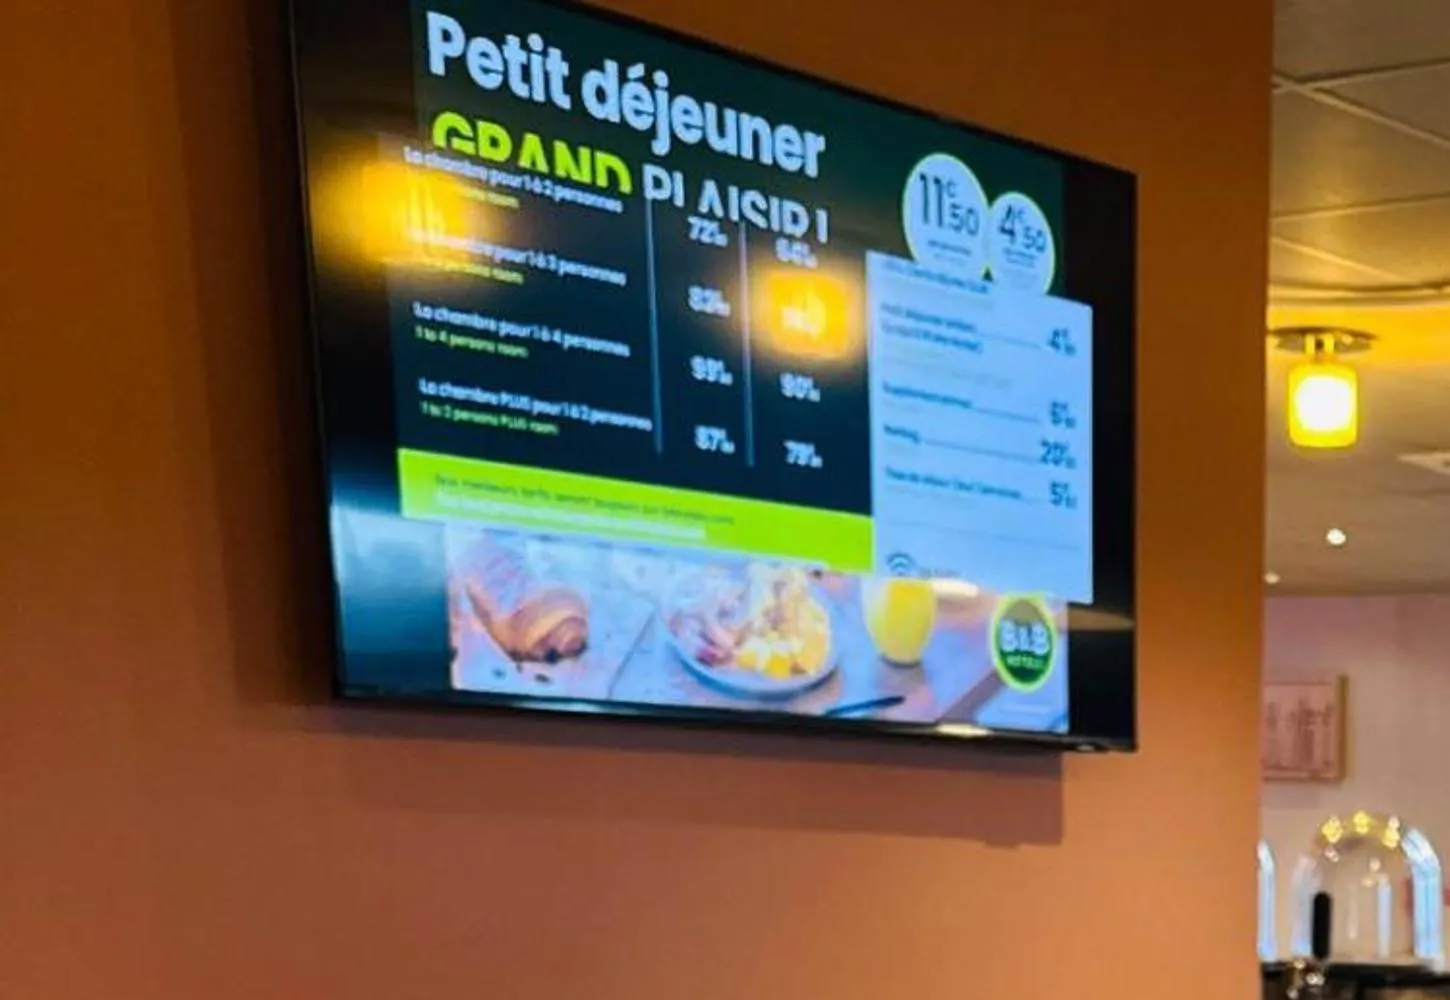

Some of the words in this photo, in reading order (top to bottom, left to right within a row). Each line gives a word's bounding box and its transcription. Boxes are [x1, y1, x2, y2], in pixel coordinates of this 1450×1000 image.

[425, 11, 571, 111] Petit
[581, 59, 826, 179] déjeuner
[434, 305, 497, 333] chambre
[498, 319, 532, 339] pour
[564, 330, 631, 358] personnes
[438, 380, 498, 405] chambre
[532, 398, 562, 417] pour
[590, 407, 653, 432] personnes
